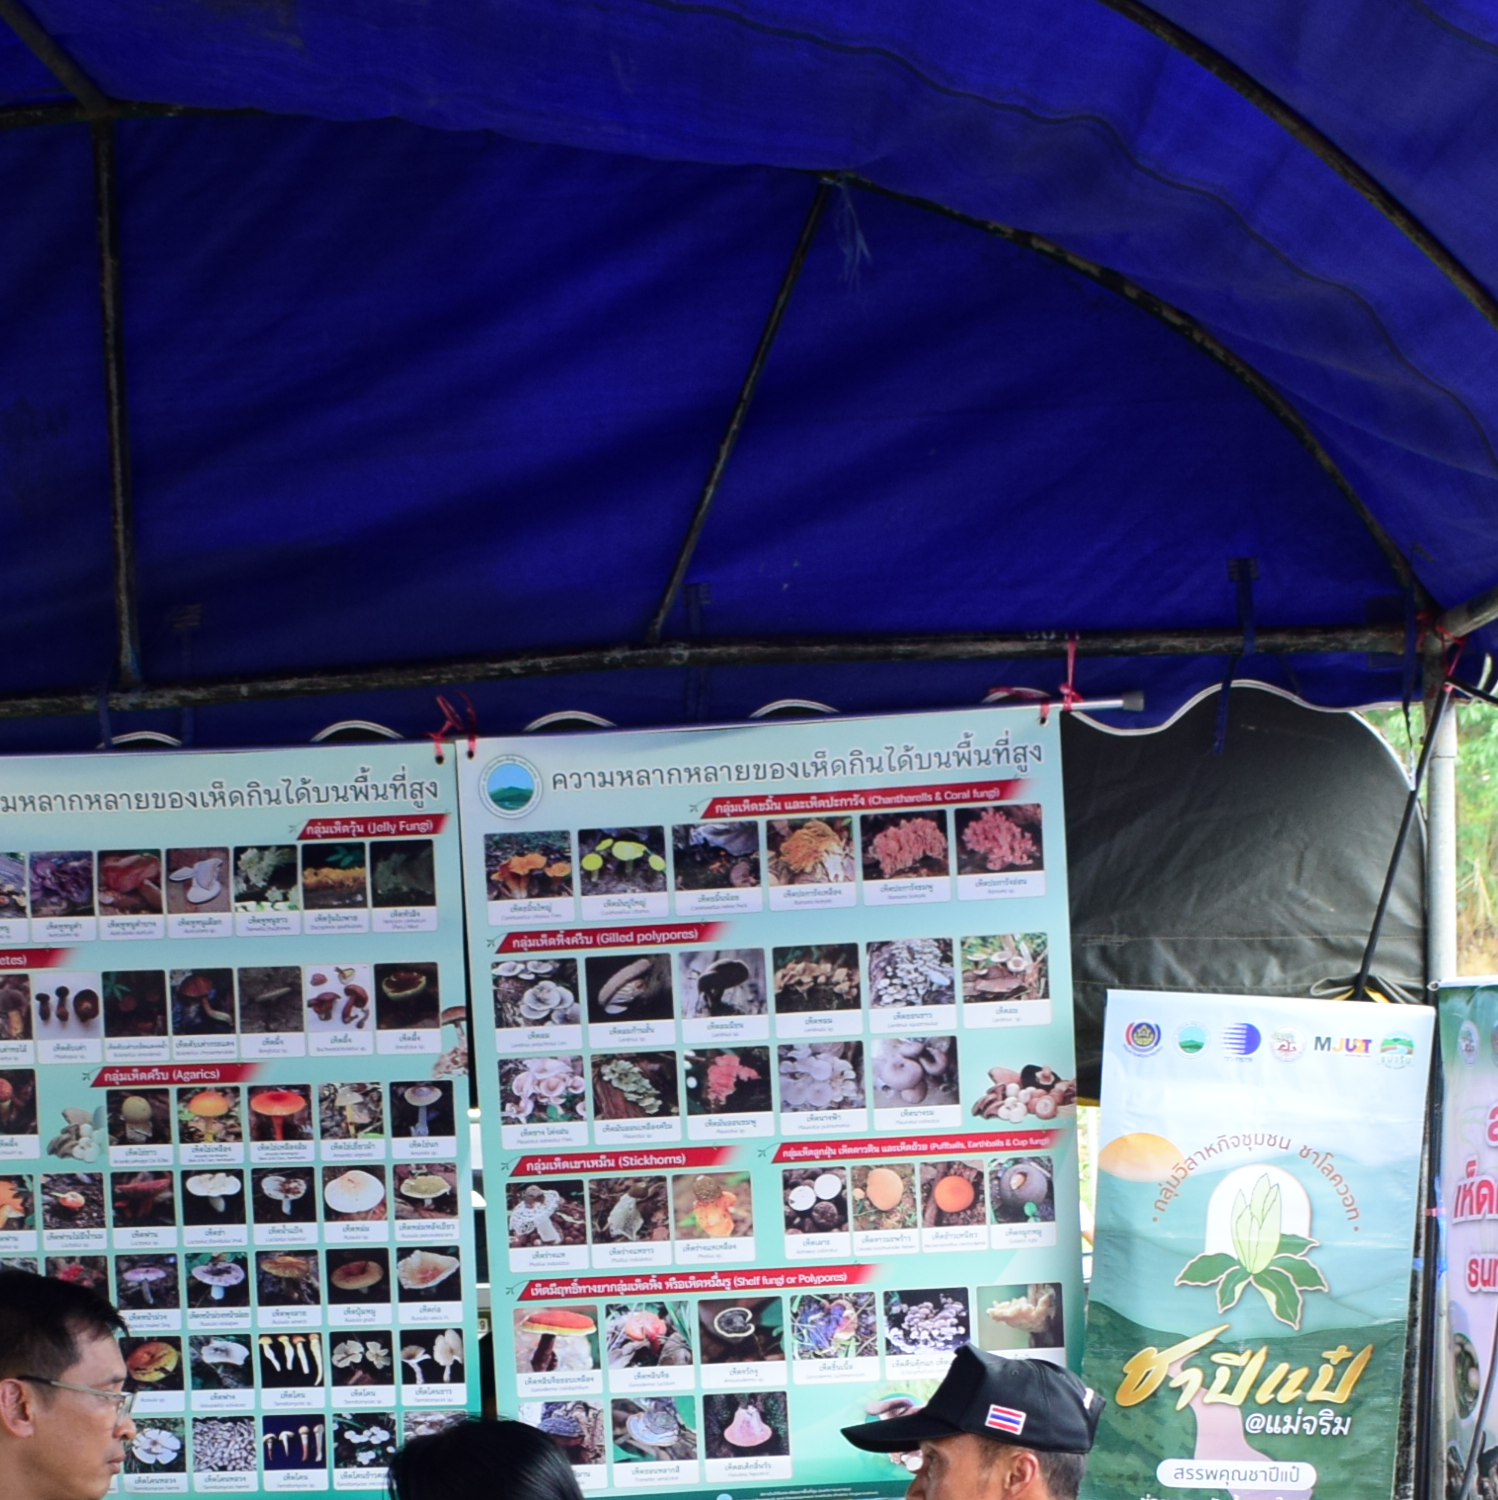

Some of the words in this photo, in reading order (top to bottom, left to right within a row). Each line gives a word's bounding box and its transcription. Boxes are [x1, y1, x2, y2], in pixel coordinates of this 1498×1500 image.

[552, 731, 1042, 790] ความหลากหลายของเห็ดกินได้บนพื้นที่สูง
[944, 789, 970, 800] Coral
[368, 822, 396, 836] (Jelly
[399, 819, 433, 833] Fungi)
[596, 932, 633, 946] (Gilled
[636, 928, 698, 944] polypores)
[172, 1068, 220, 1082] (Agarics)
[1153, 1133, 1292, 1213] กลุ่มวิสาหกิจชุมชน
[1298, 1145, 1360, 1222] ชาโลควอท
[733, 1275, 759, 1289] (Shelf
[761, 1273, 784, 1288] fungi
[786, 1275, 797, 1285] or
[798, 1271, 847, 1286] Polypores)
[1244, 1407, 1351, 1437] @แม่จริม
[1173, 1465, 1301, 1486] สรรพคุณชาปีแป๋
